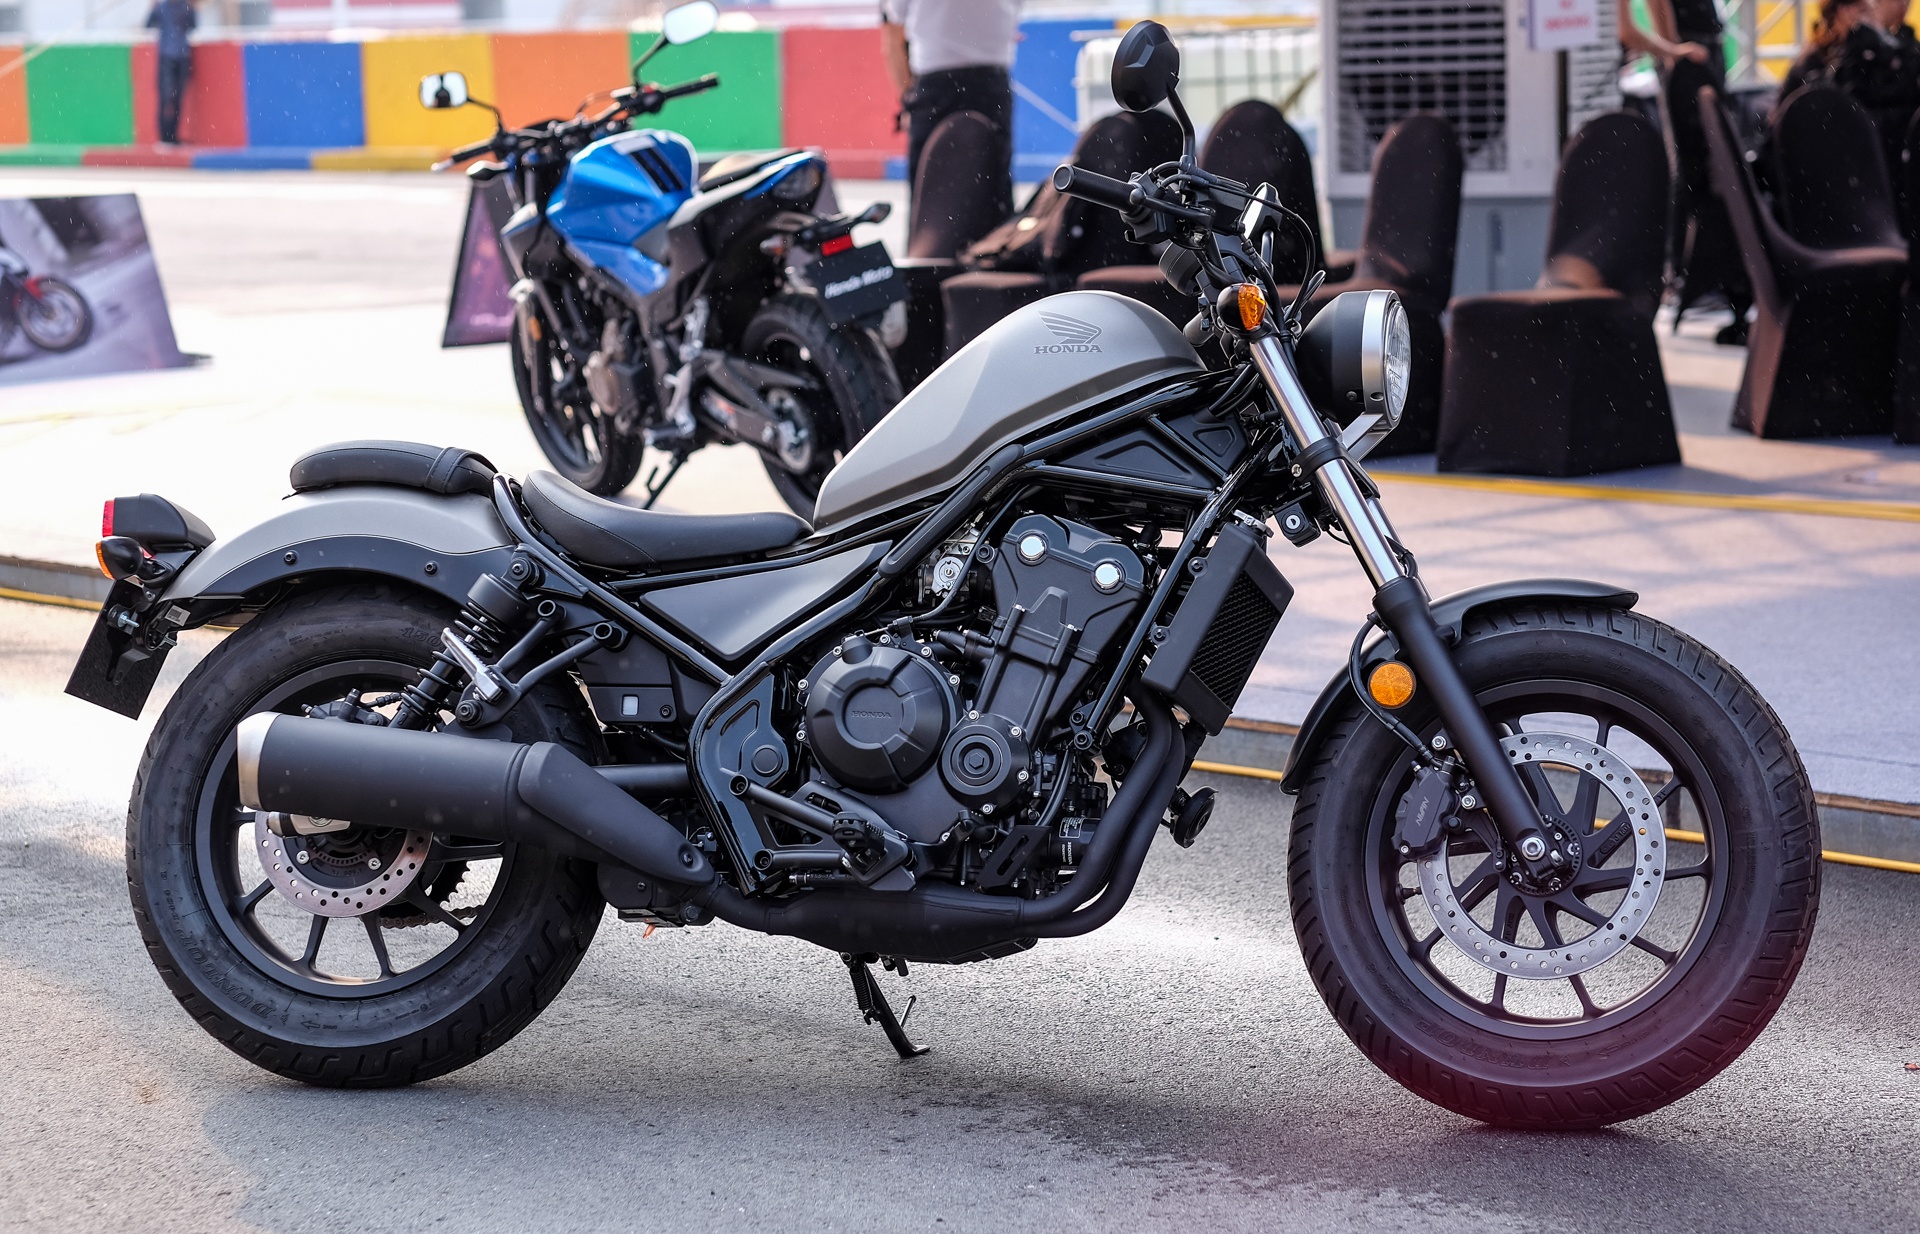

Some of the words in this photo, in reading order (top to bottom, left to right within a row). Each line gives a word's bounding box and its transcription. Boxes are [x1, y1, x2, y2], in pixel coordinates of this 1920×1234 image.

[1034, 344, 1104, 355] HONDA
[851, 710, 893, 719] HONDA
[175, 928, 277, 1021] DUNLOP
[1414, 1019, 1552, 1069] DUNLOP
